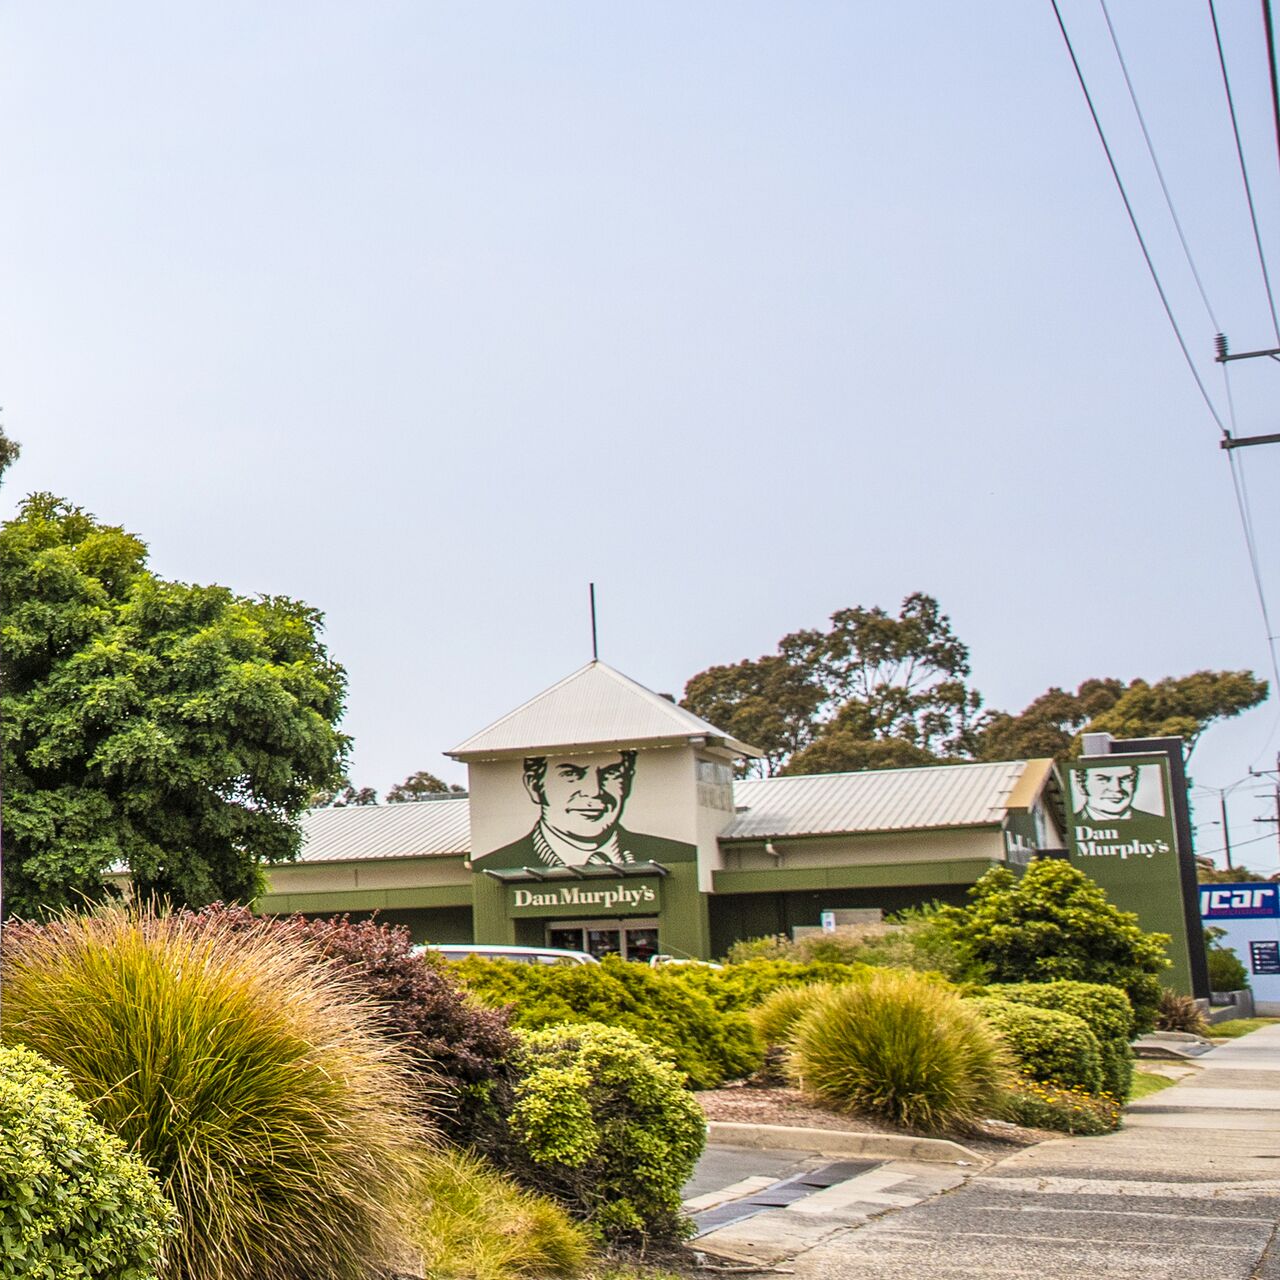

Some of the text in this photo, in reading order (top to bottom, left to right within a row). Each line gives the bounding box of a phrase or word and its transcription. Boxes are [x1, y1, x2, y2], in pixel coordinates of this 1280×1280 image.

[1075, 825, 1118, 841] Dan
[1076, 839, 1170, 859] Murphy's
[514, 885, 655, 908] Dan Murphy's
